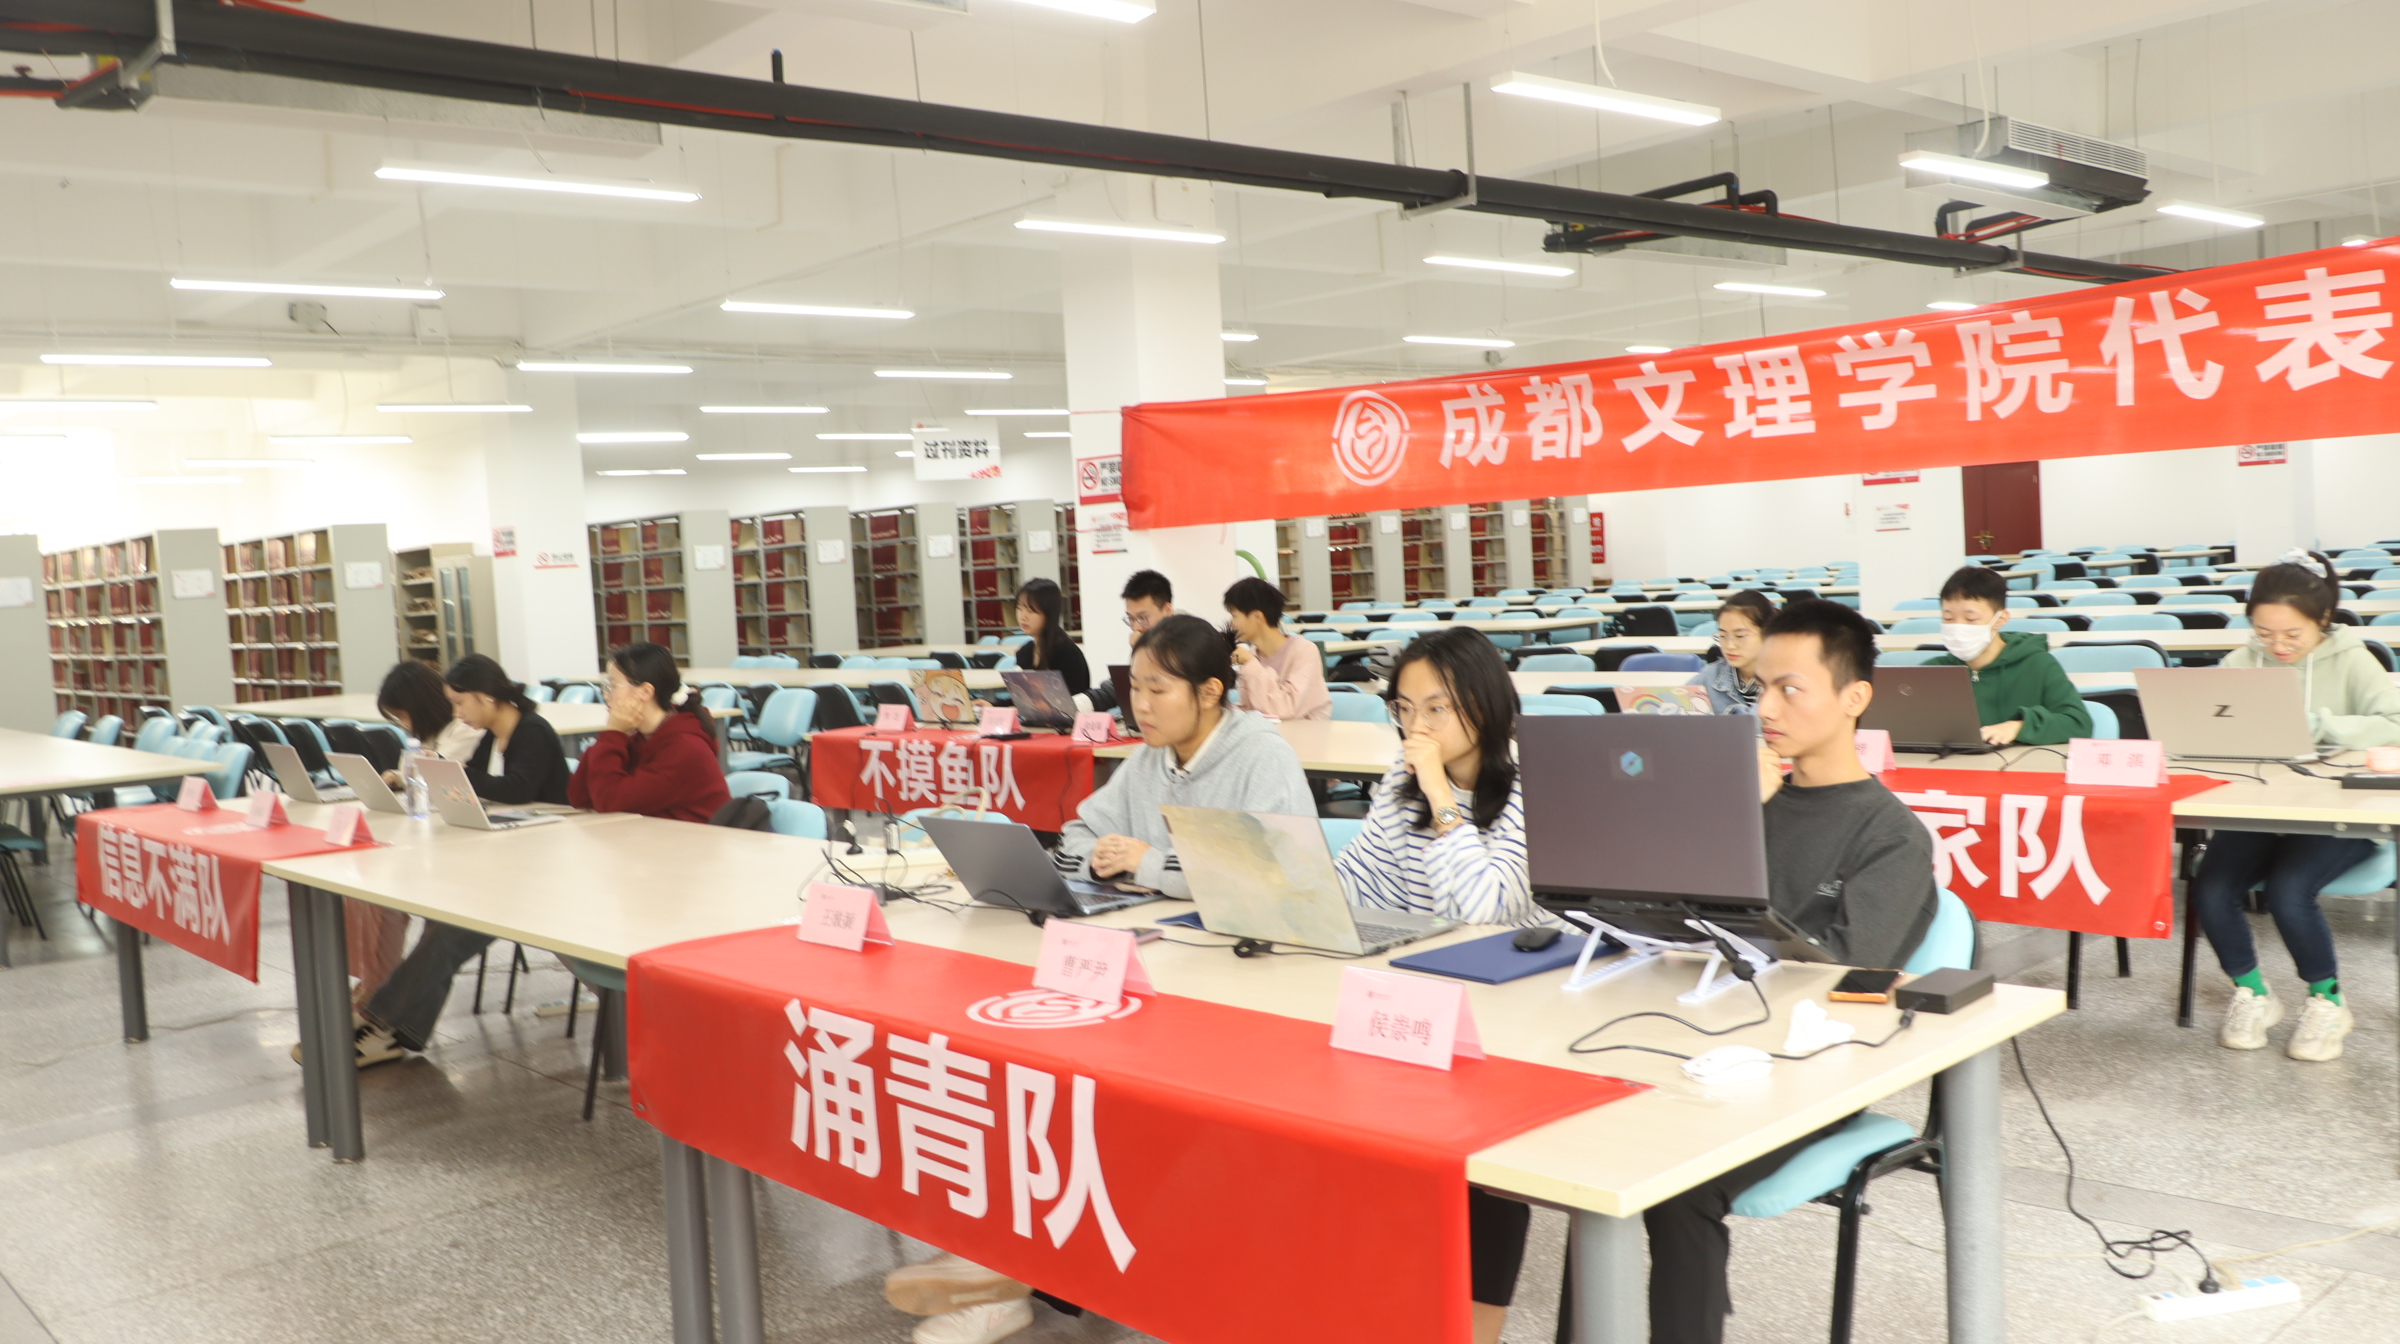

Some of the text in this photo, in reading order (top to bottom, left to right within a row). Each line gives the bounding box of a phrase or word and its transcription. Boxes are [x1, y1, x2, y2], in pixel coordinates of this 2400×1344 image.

[1437, 267, 2395, 470] 成都文理学院代表
[858, 738, 1026, 812] 不摸鱼队
[99, 820, 231, 947] 信息不满队
[783, 997, 1138, 1274] 涌青队
